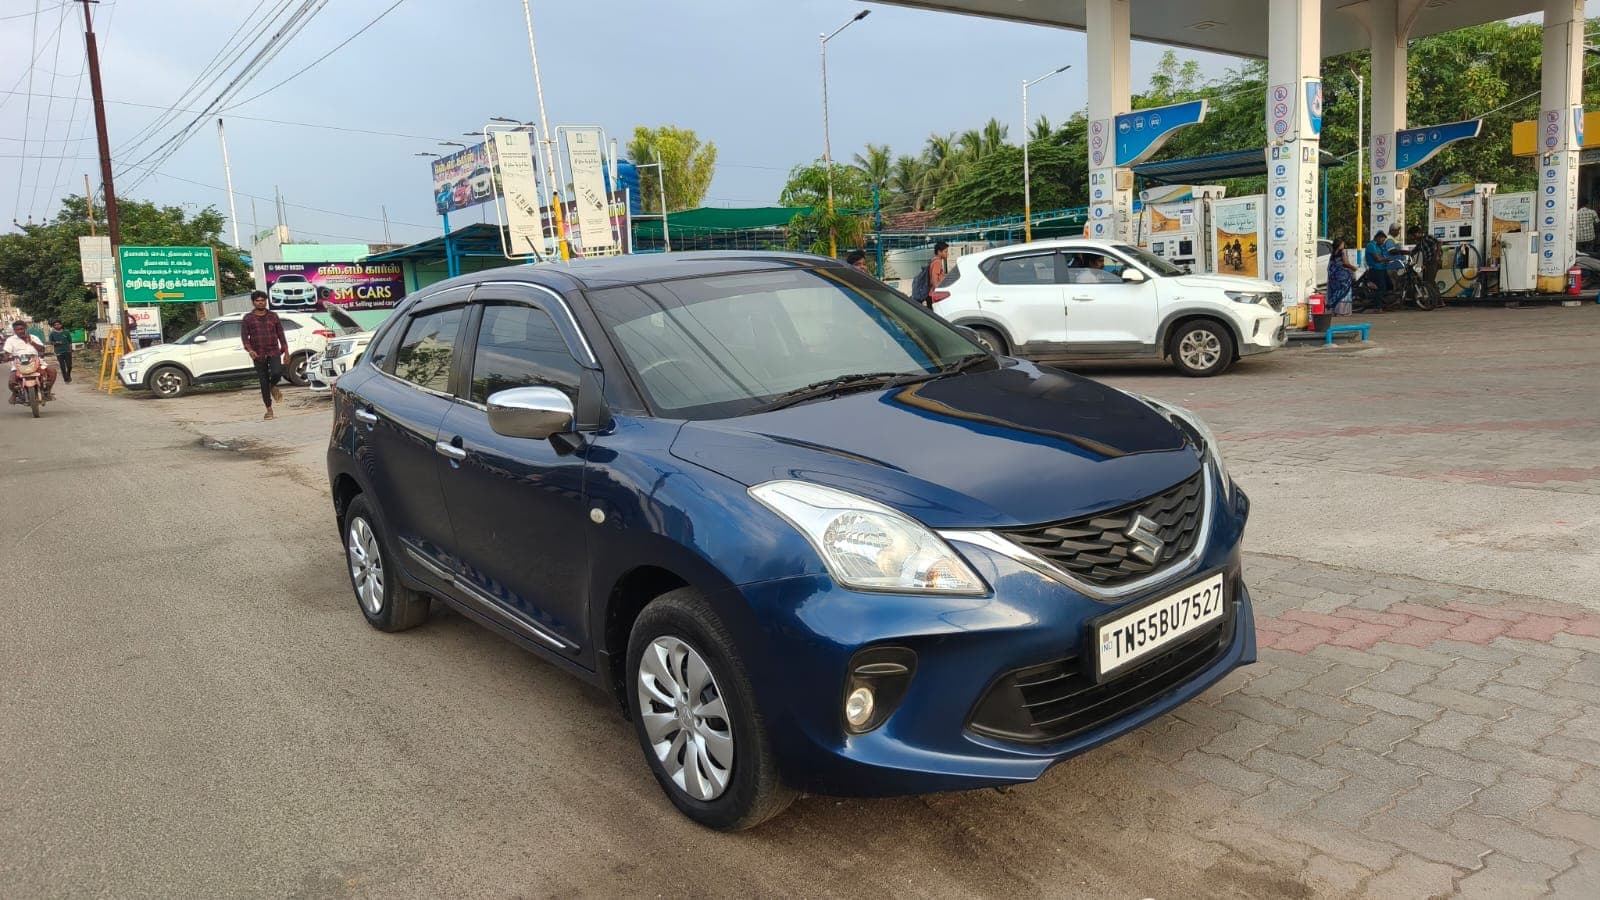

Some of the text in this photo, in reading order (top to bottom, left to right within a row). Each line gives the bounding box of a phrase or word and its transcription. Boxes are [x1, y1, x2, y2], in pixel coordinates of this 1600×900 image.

[1122, 144, 1127, 154] 1
[1403, 154, 1409, 162] 3
[334, 286, 392, 300] SM CARS
[1113, 583, 1221, 659] TN55BU7527
